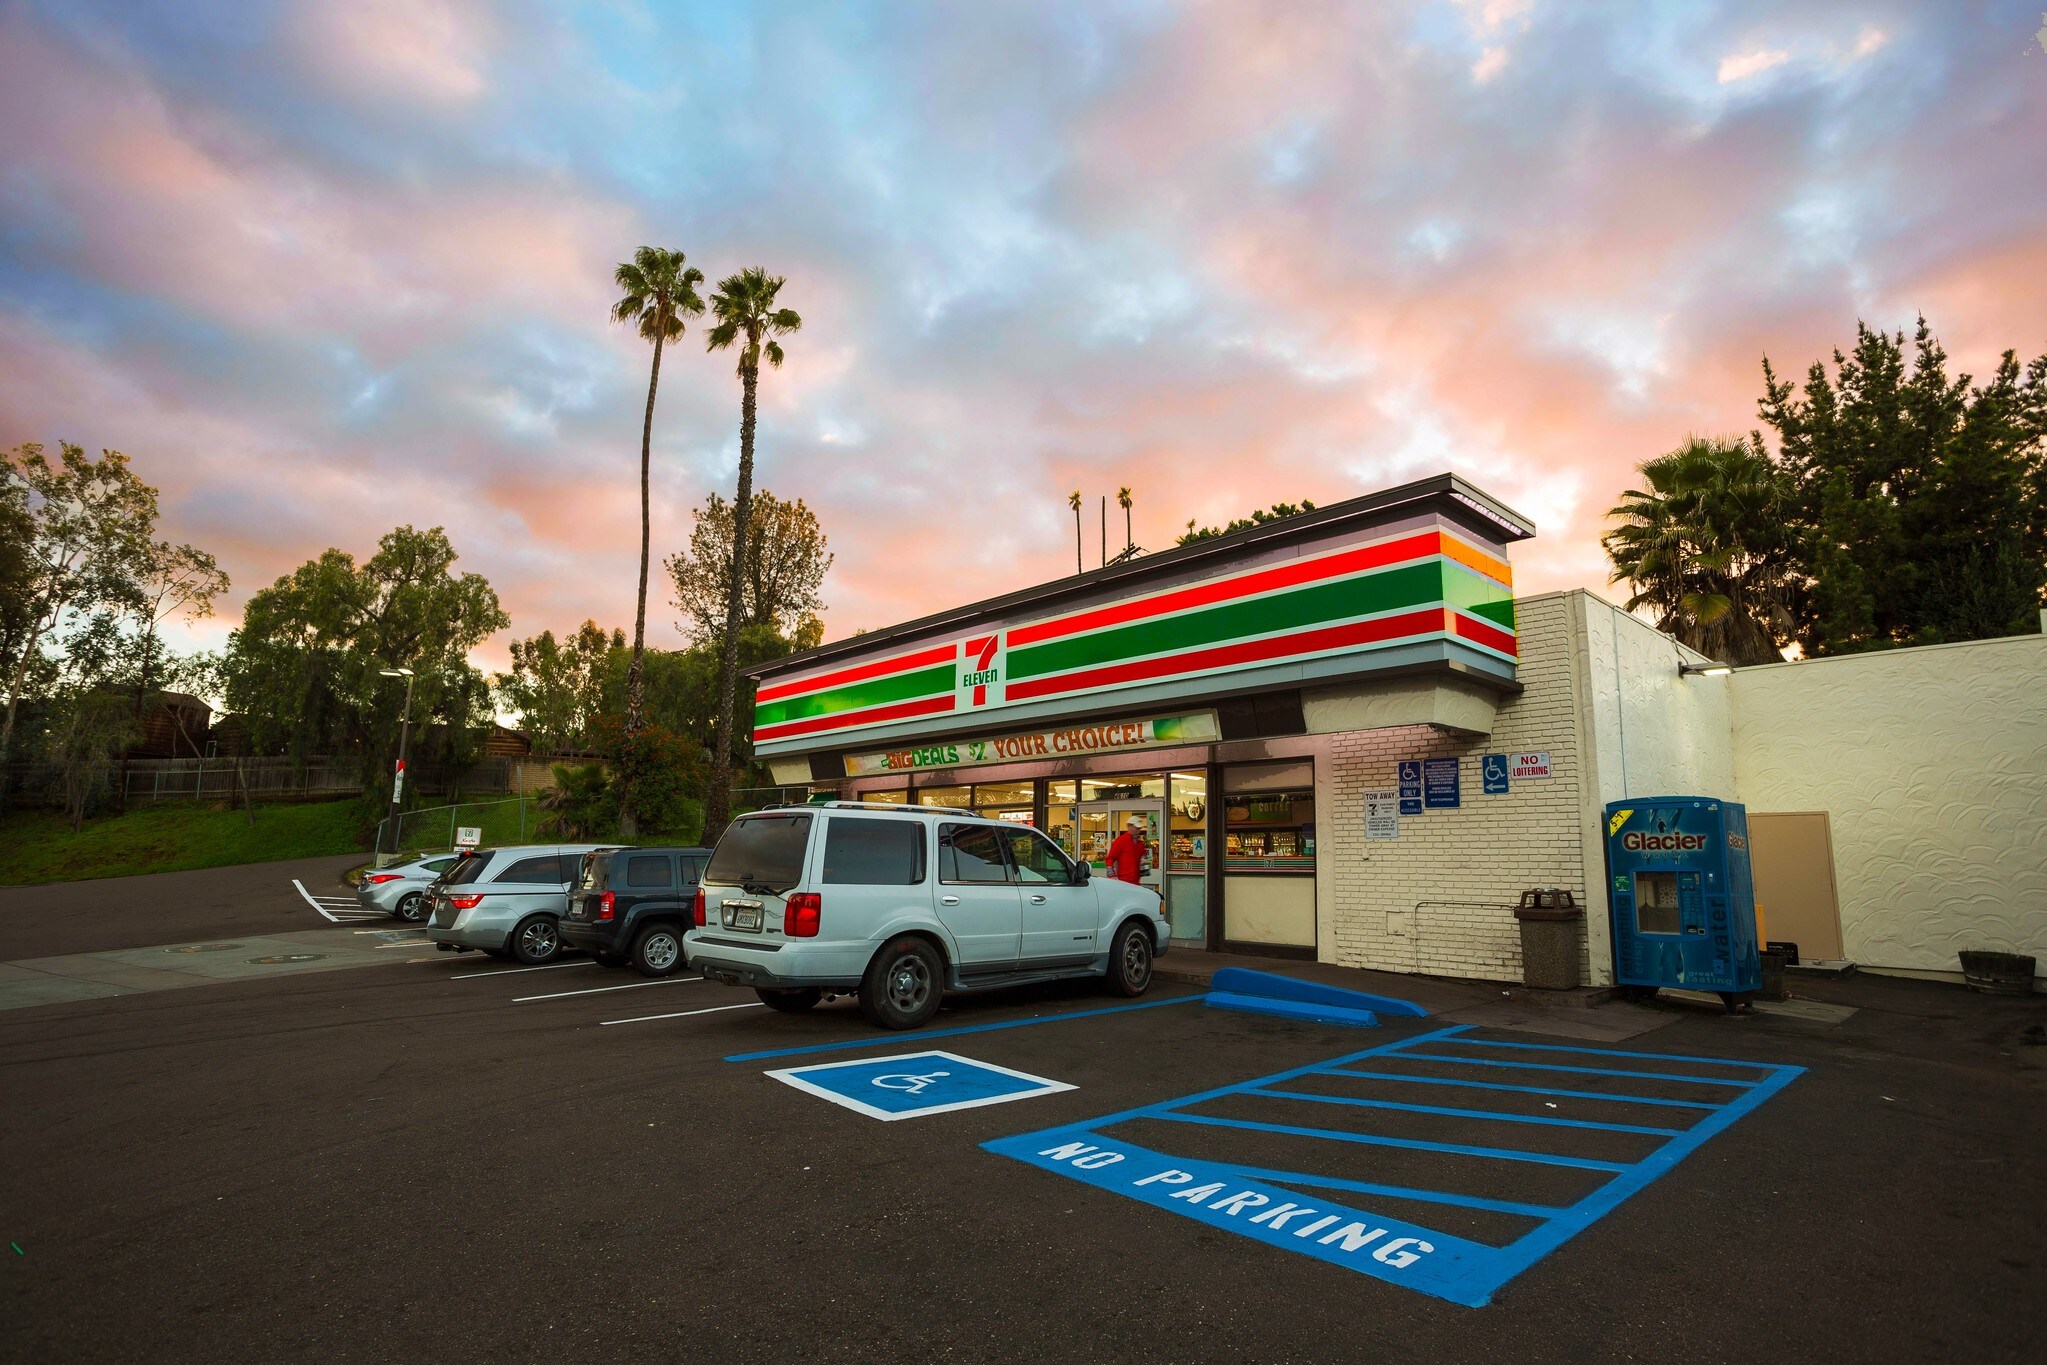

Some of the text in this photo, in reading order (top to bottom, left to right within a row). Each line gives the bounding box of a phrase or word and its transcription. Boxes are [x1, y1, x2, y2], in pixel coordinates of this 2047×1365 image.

[965, 634, 998, 706] 7
[993, 735, 1049, 758] YOUR
[1053, 723, 1147, 752] CHOICE!
[1520, 755, 1538, 765] NO
[1513, 765, 1548, 776] LOITERING
[1380, 792, 1395, 800] AWAY
[1403, 789, 1416, 797] ONLY
[1368, 803, 1377, 816] 7
[1195, 840, 1203, 850] A
[1623, 832, 1707, 850] Glacier
[1686, 975, 1733, 986] tasting
[1037, 1141, 1435, 1269] NO PARKING
